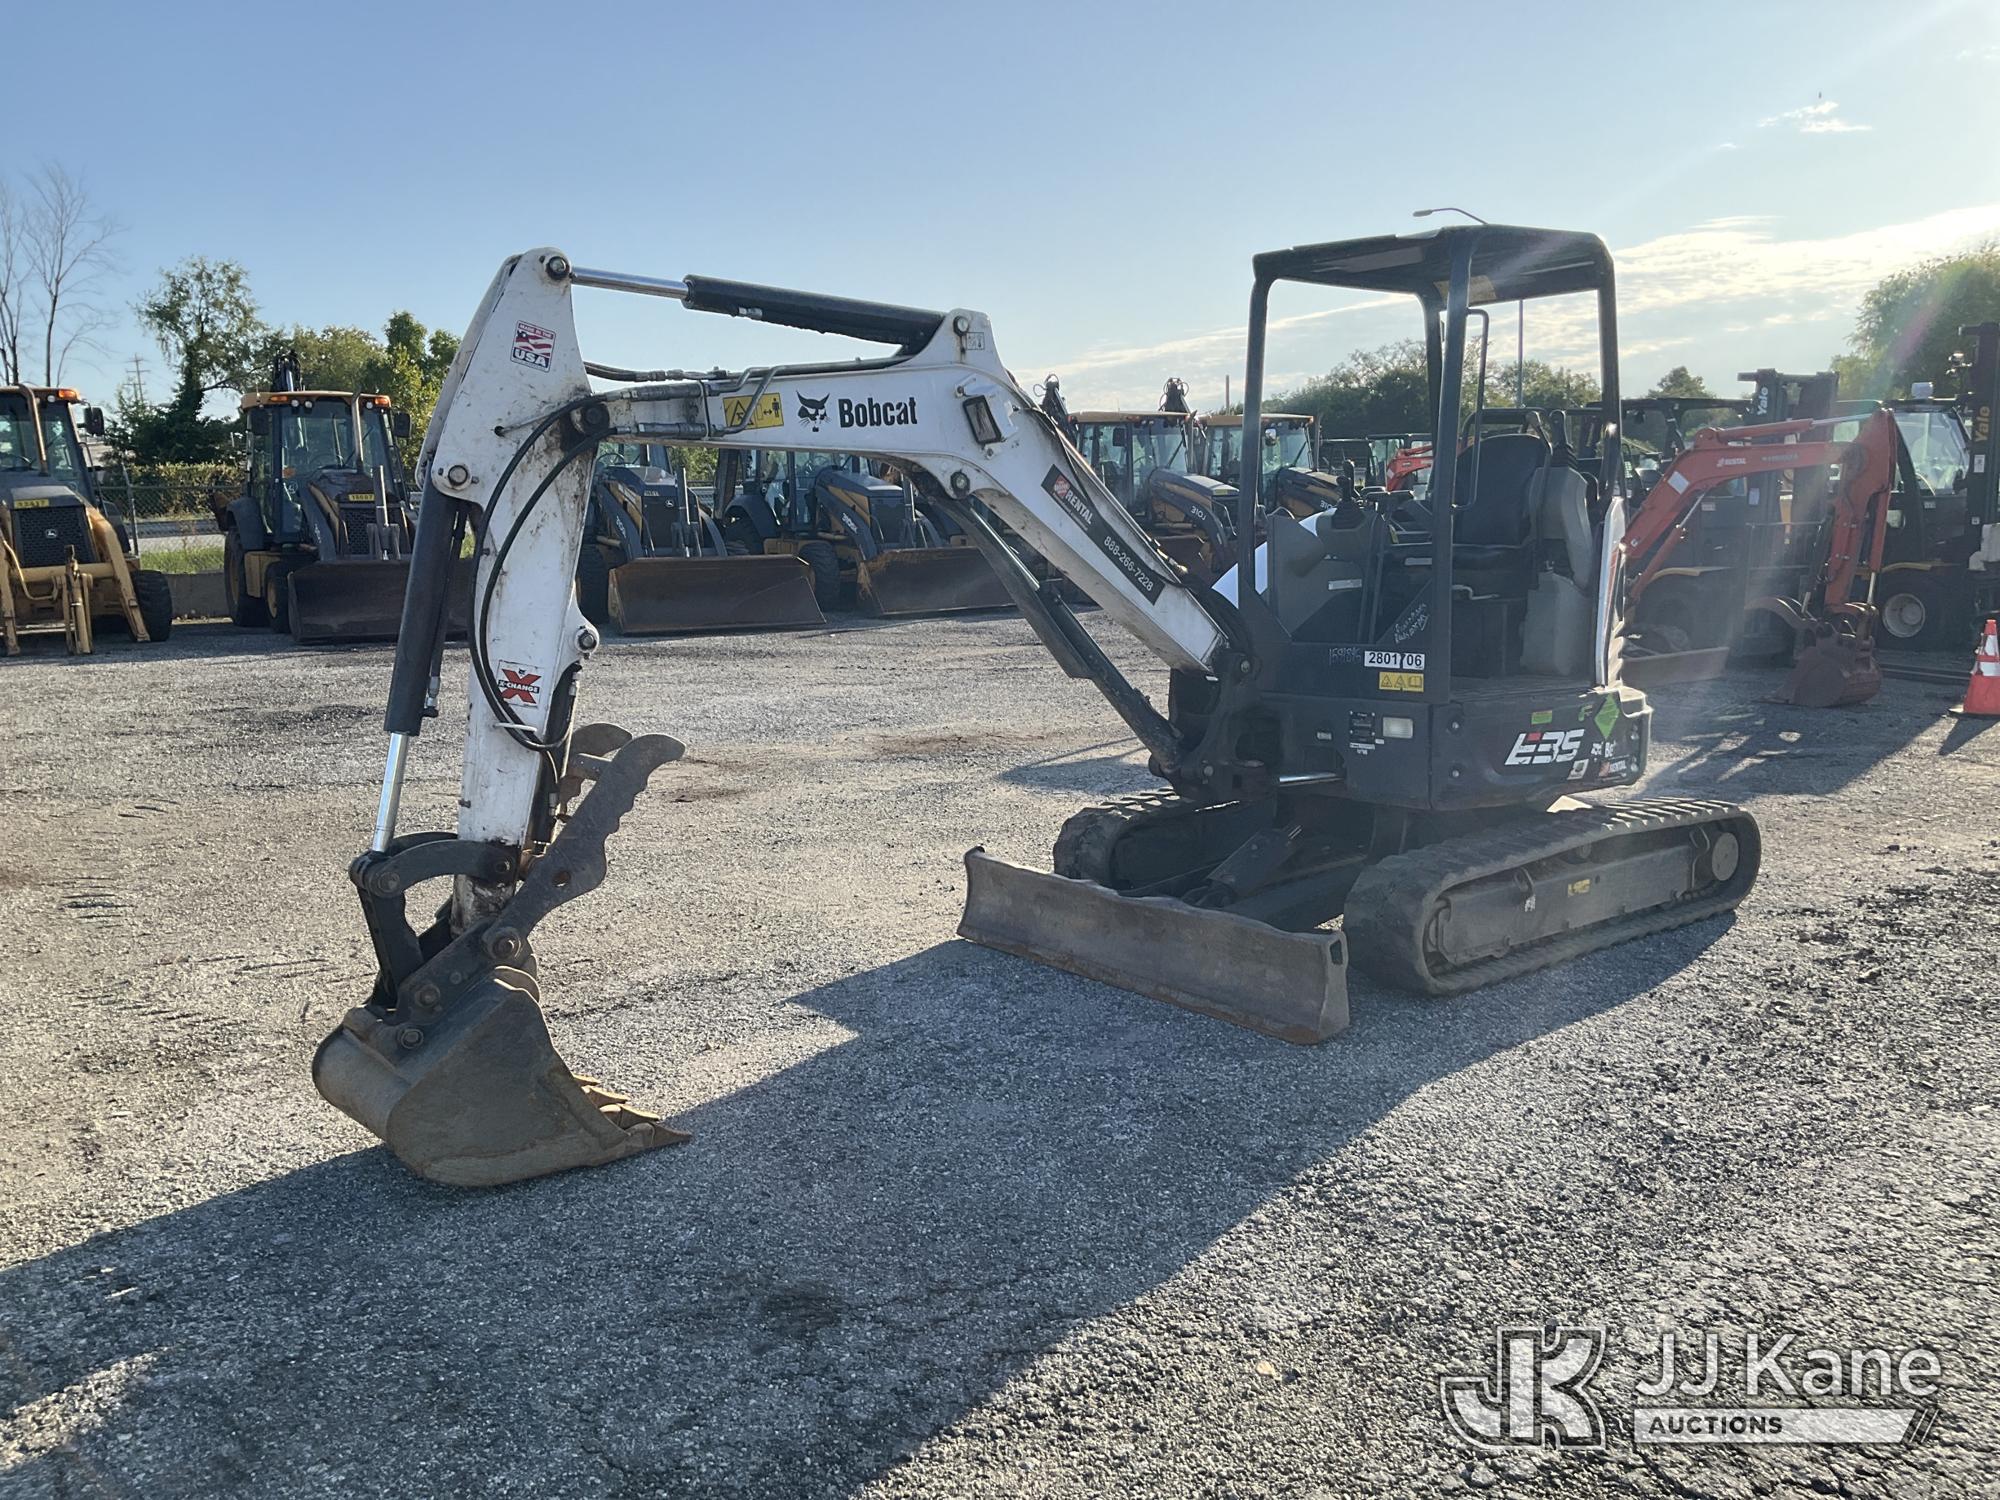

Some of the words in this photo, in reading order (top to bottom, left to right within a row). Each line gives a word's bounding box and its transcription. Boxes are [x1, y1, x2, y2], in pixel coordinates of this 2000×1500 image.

[513, 348, 546, 367] USA
[838, 397, 918, 428] Bobcat
[1757, 386, 1769, 416] Yale
[1974, 405, 1990, 442] Yale
[1065, 489, 1094, 525] RENTAL
[1190, 505, 1207, 521] 310J
[1104, 536, 1154, 591] 888-266-7228
[1504, 728, 1585, 766] E35
